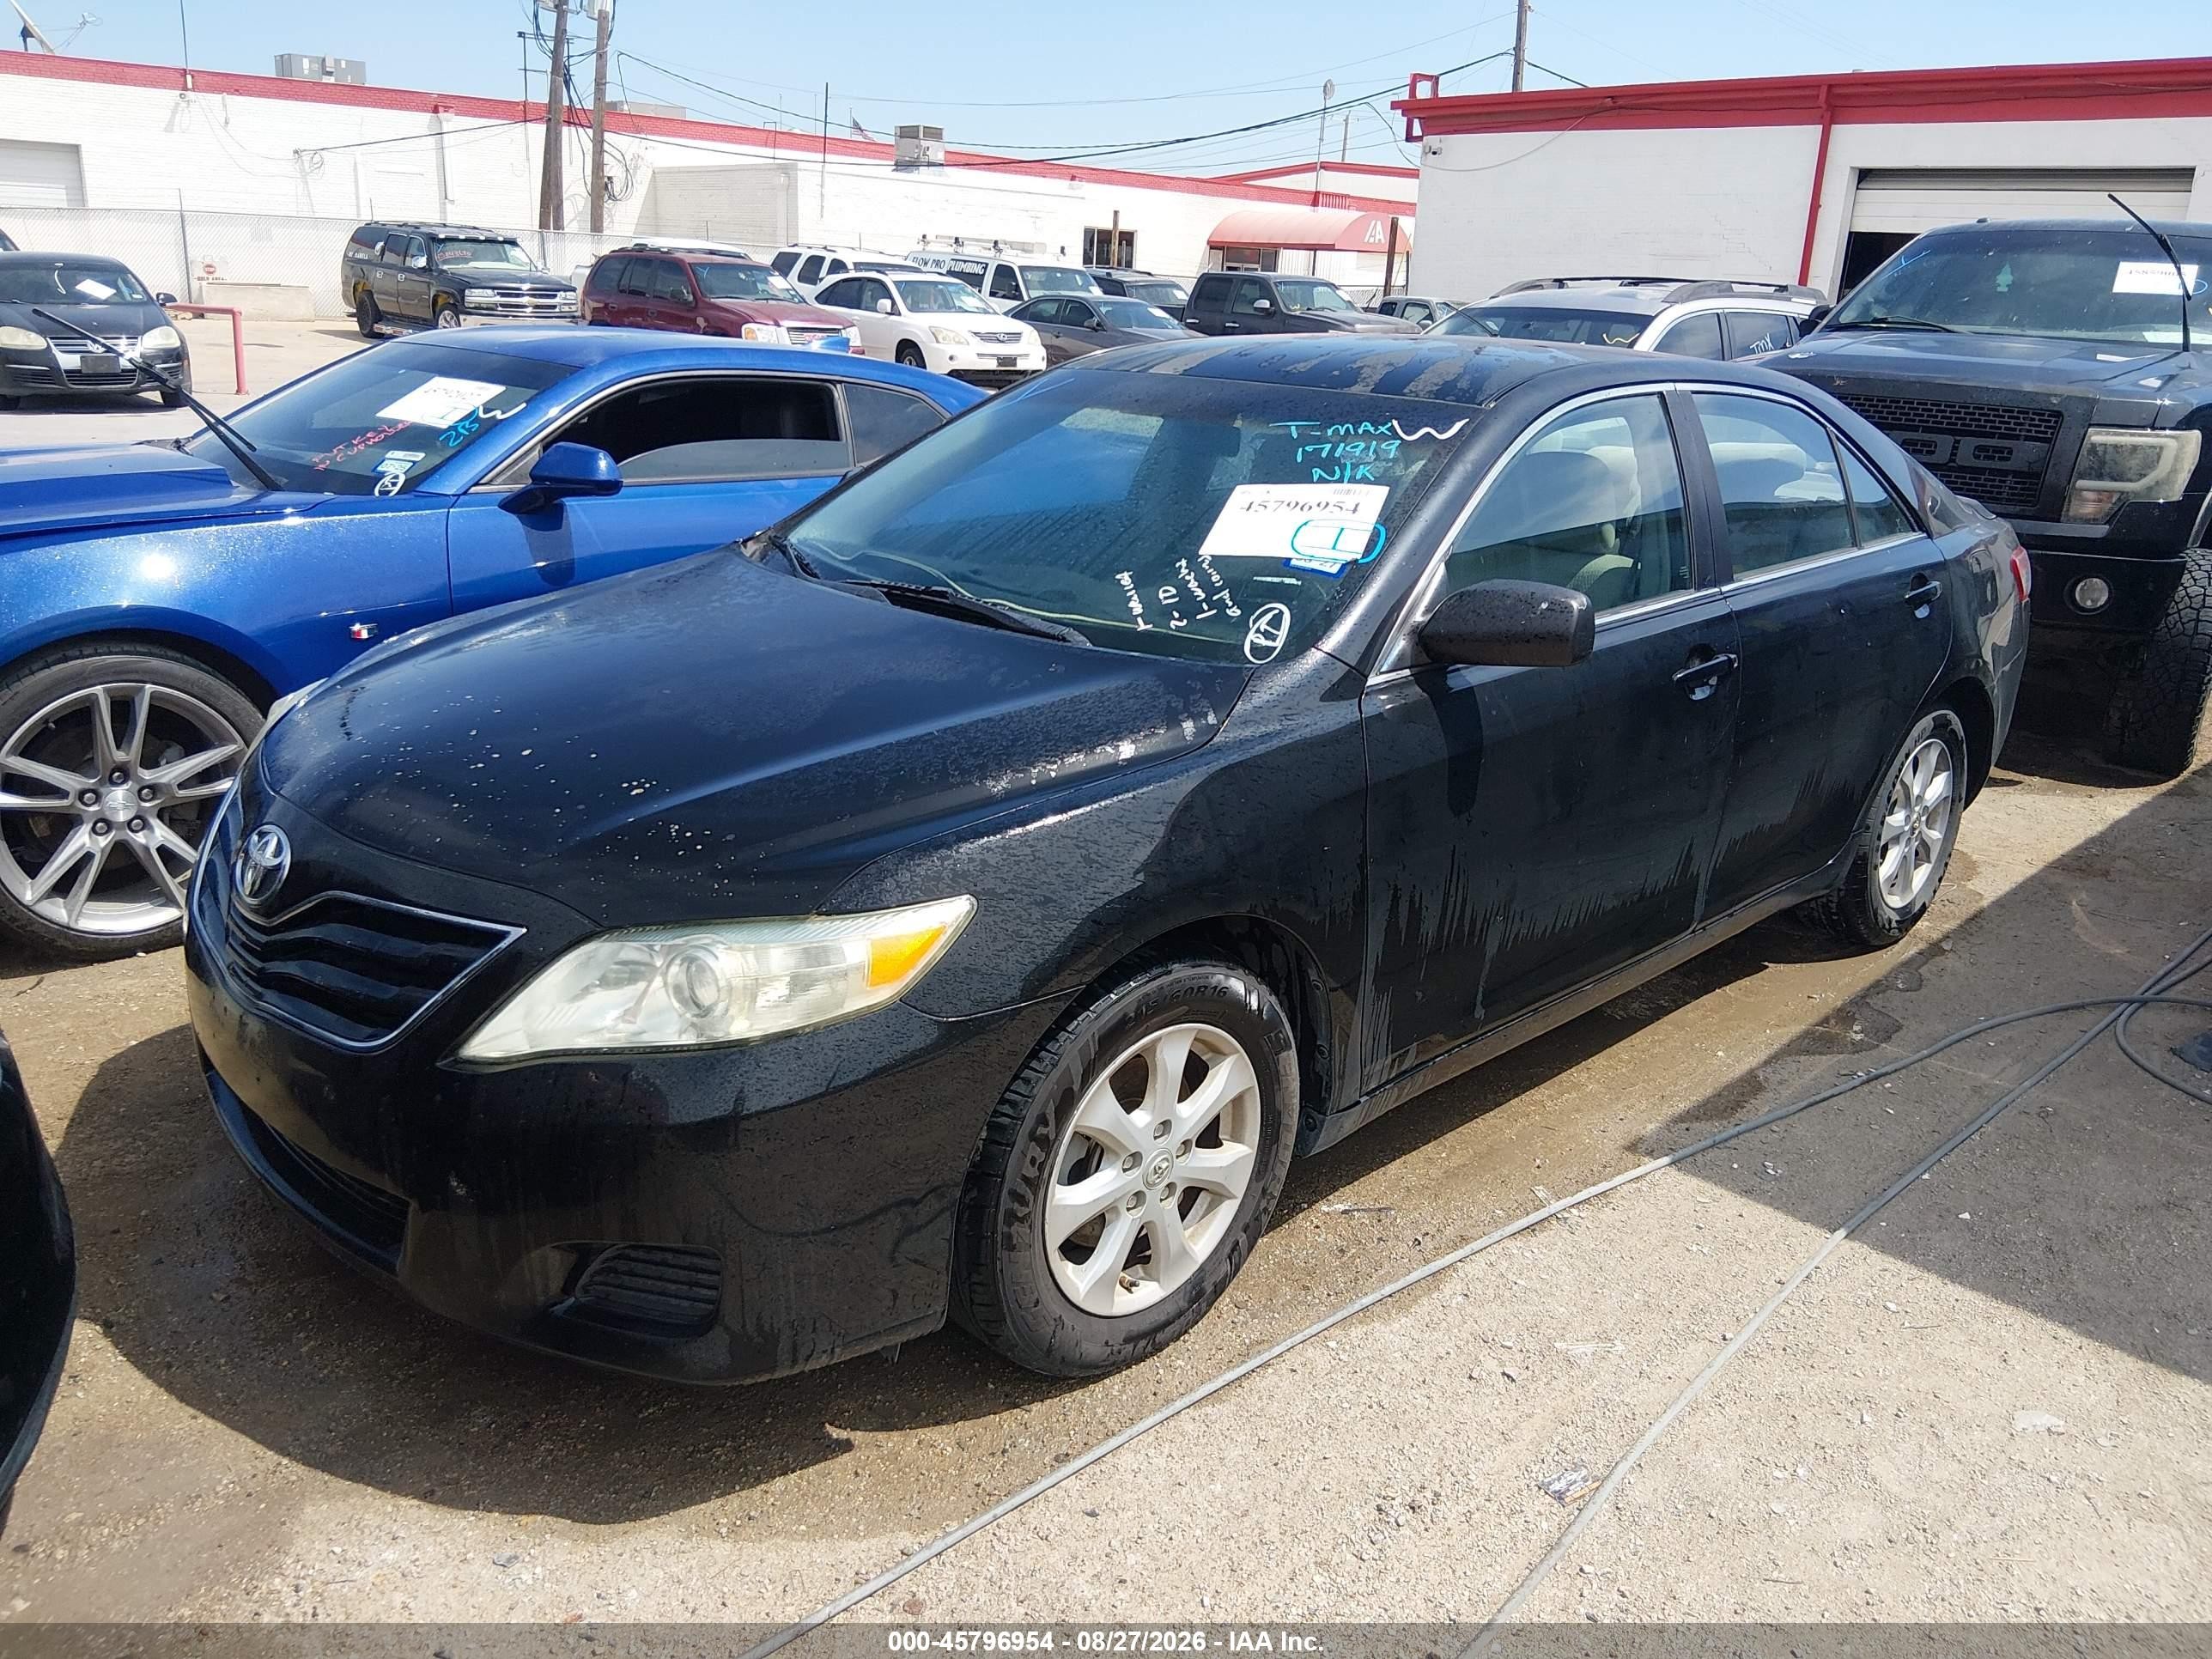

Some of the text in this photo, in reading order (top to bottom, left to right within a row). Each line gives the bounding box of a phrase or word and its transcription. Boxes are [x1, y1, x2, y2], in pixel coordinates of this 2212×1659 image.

[930, 258, 946, 270] PRO
[947, 260, 987, 275] PLUMBING
[1239, 500, 1361, 514] 45796954
